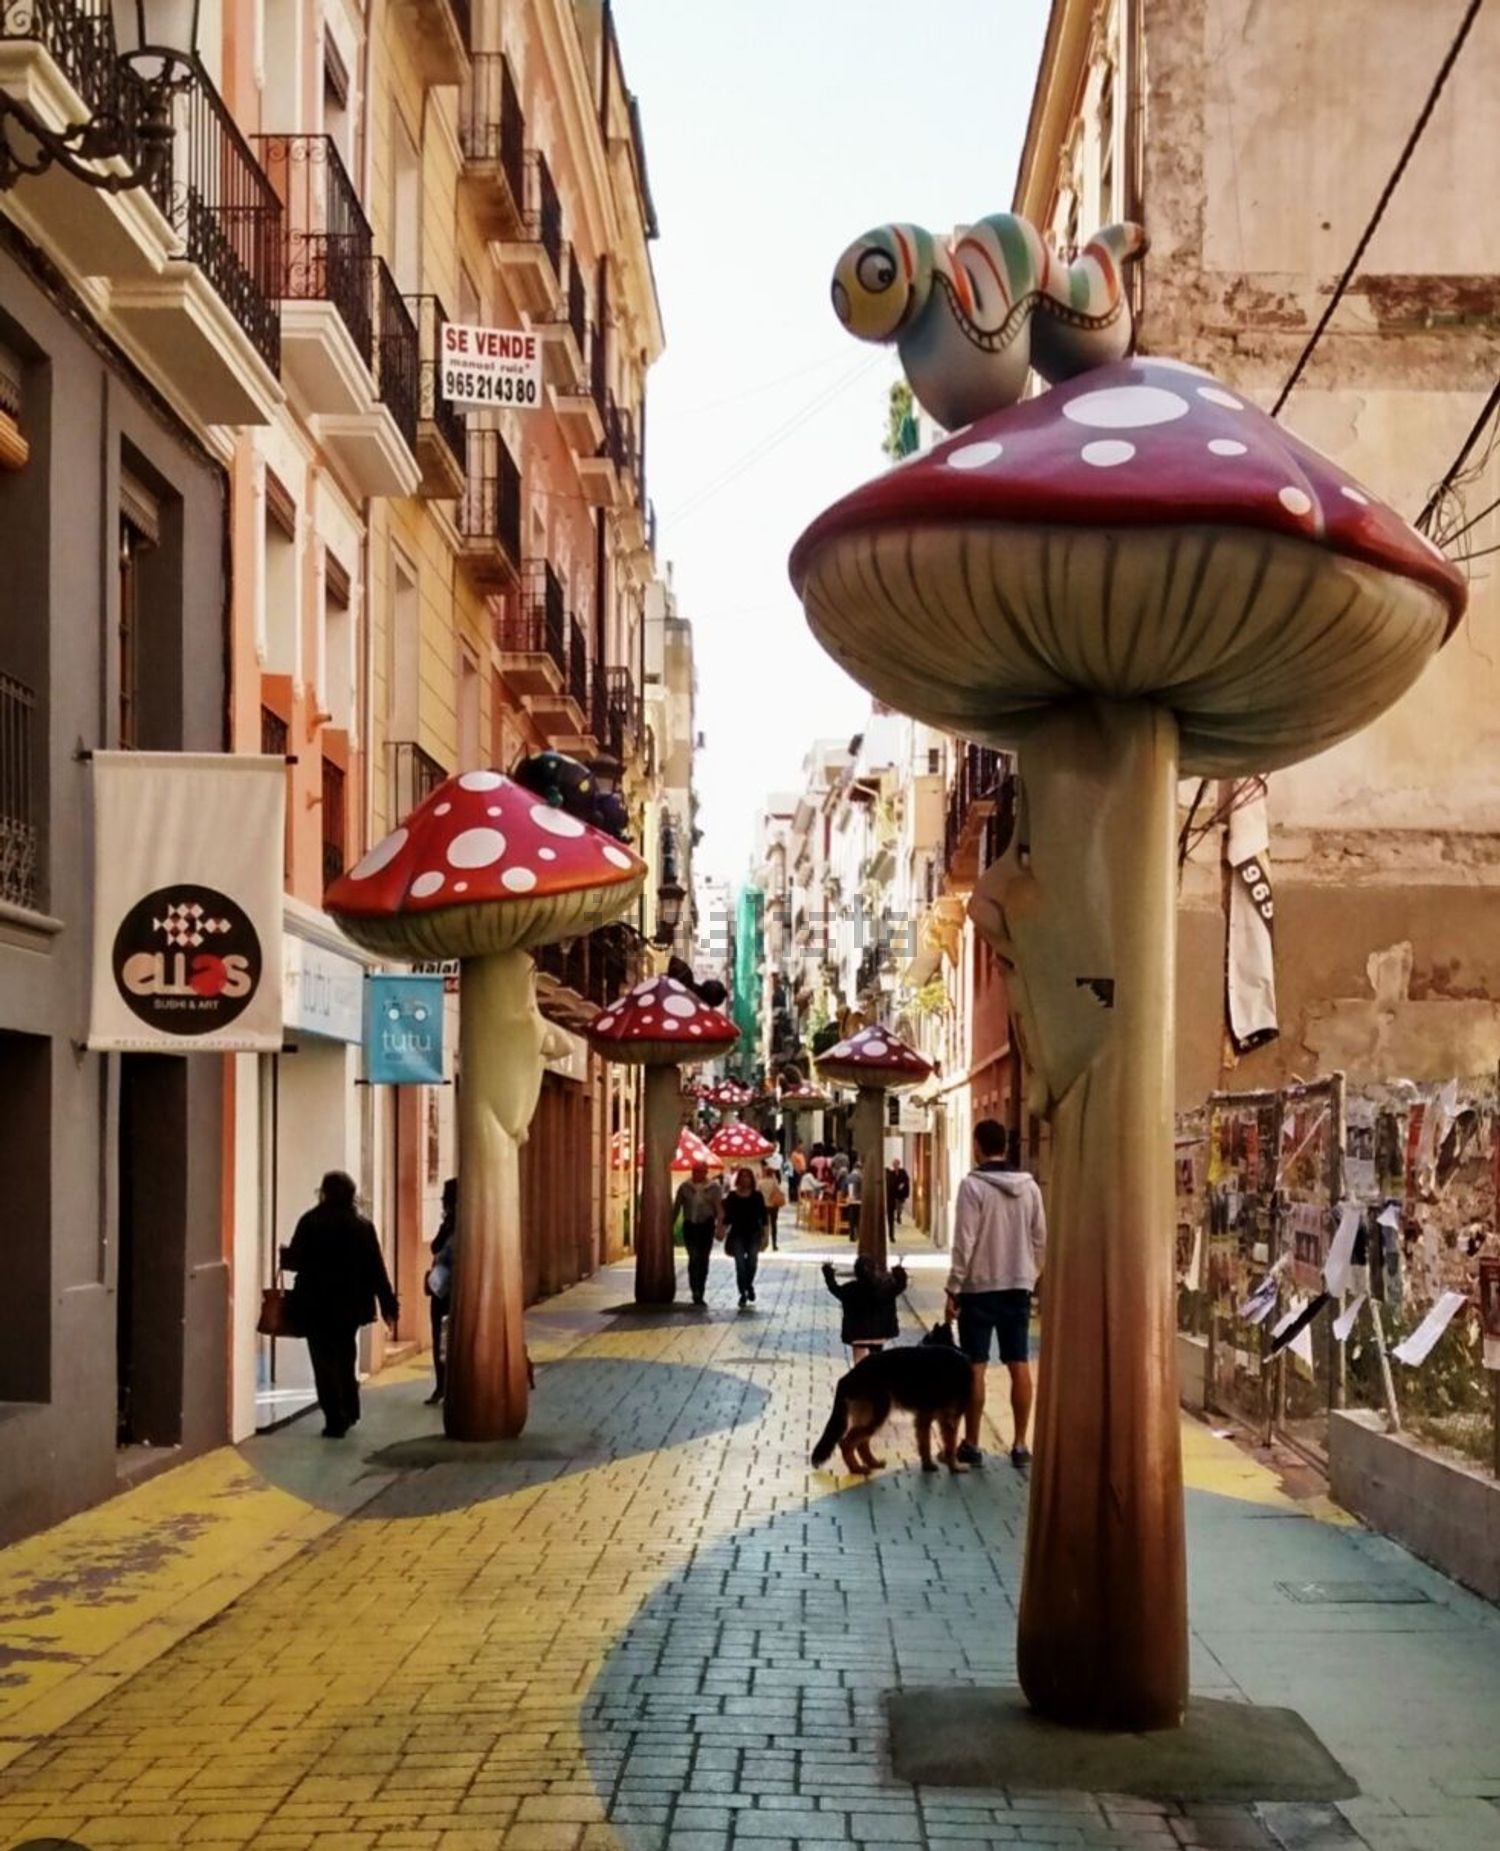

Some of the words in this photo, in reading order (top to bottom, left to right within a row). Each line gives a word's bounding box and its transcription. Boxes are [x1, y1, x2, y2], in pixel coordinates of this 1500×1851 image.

[446, 328, 468, 352] SE
[475, 331, 536, 360] VENDE
[446, 370, 536, 404] 965214380
[153, 998, 187, 1010] SUSHI
[189, 999, 196, 1010] &
[198, 999, 219, 1010] ART
[382, 1030, 432, 1051] tutu
